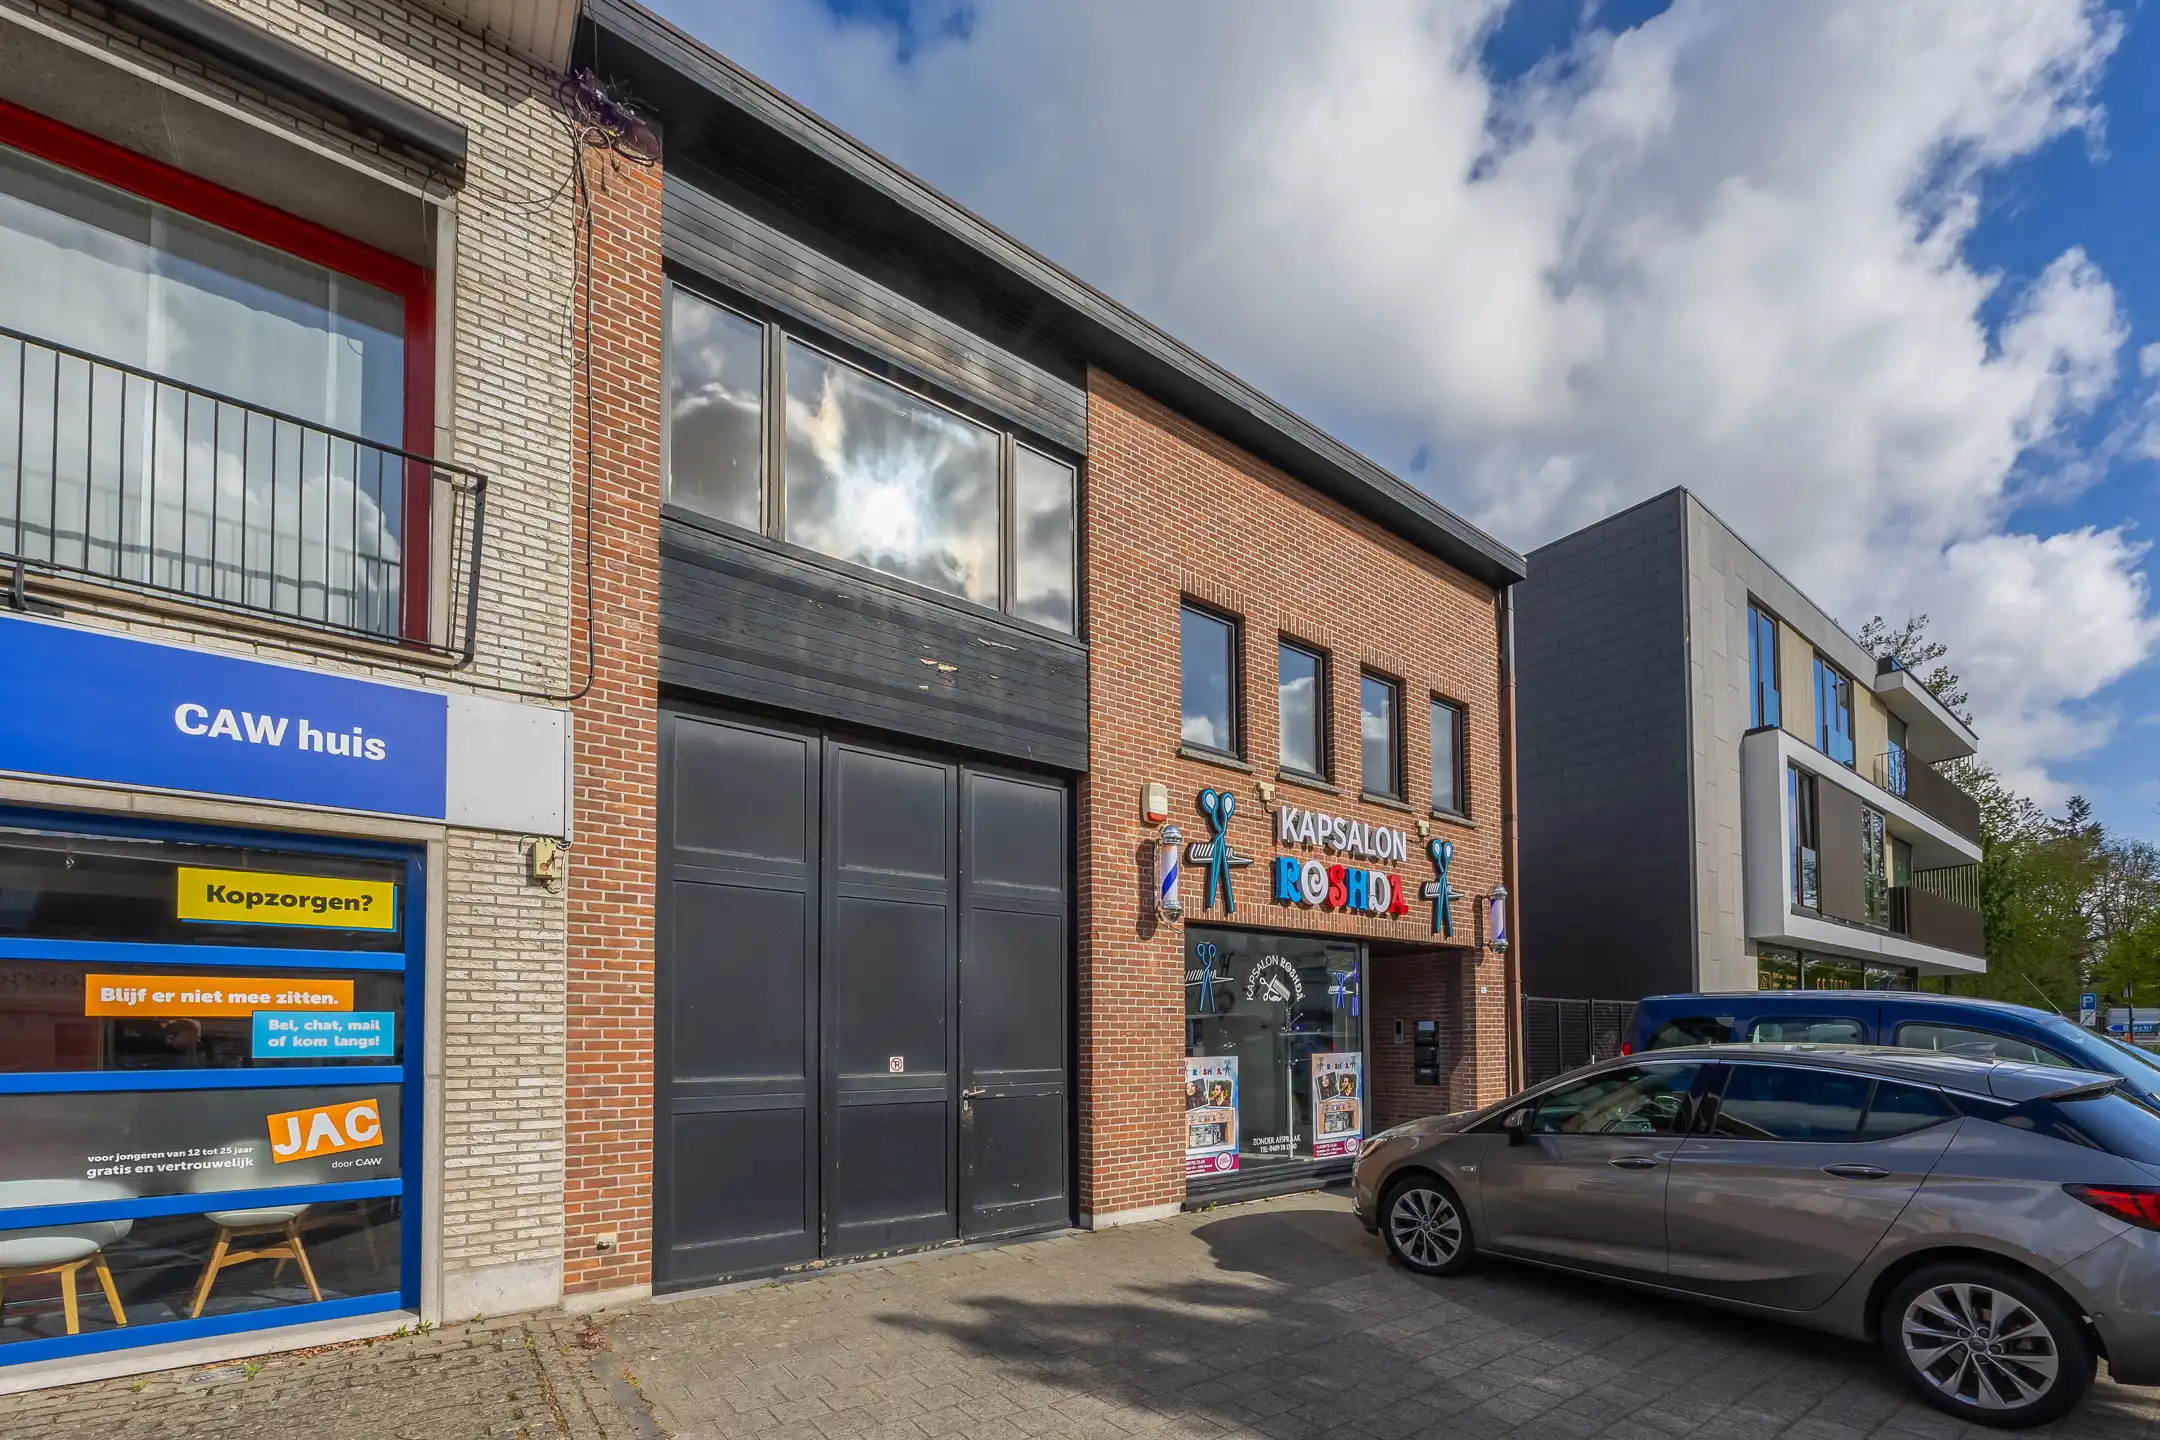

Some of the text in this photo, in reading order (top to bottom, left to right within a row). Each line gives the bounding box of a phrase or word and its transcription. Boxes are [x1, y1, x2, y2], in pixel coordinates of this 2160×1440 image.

[174, 703, 386, 761] CAW huis
[1279, 805, 1407, 862] KAPSALON
[1276, 856, 1408, 915] ROSHDA
[206, 884, 374, 914] Kopzorgen?
[1246, 955, 1304, 1001] KAPSALON ROSHDA
[100, 987, 339, 1006] Blijf er niet mee zitten.
[2083, 997, 2093, 1008] P
[268, 1019, 380, 1032] Bel, chat, mail
[268, 1035, 380, 1050] of kom langs!
[273, 1106, 379, 1155] JAC
[1252, 1136, 1275, 1146] ZONDER
[87, 1154, 114, 1163] voor
[114, 1150, 165, 1162] jongeren
[187, 1149, 200, 1157] 12
[201, 1147, 218, 1156] tot
[219, 1147, 233, 1155] 25
[233, 1146, 254, 1156] jaar
[331, 1157, 383, 1169] door CAW
[86, 1157, 254, 1180] gratis en vertrouwelijk
